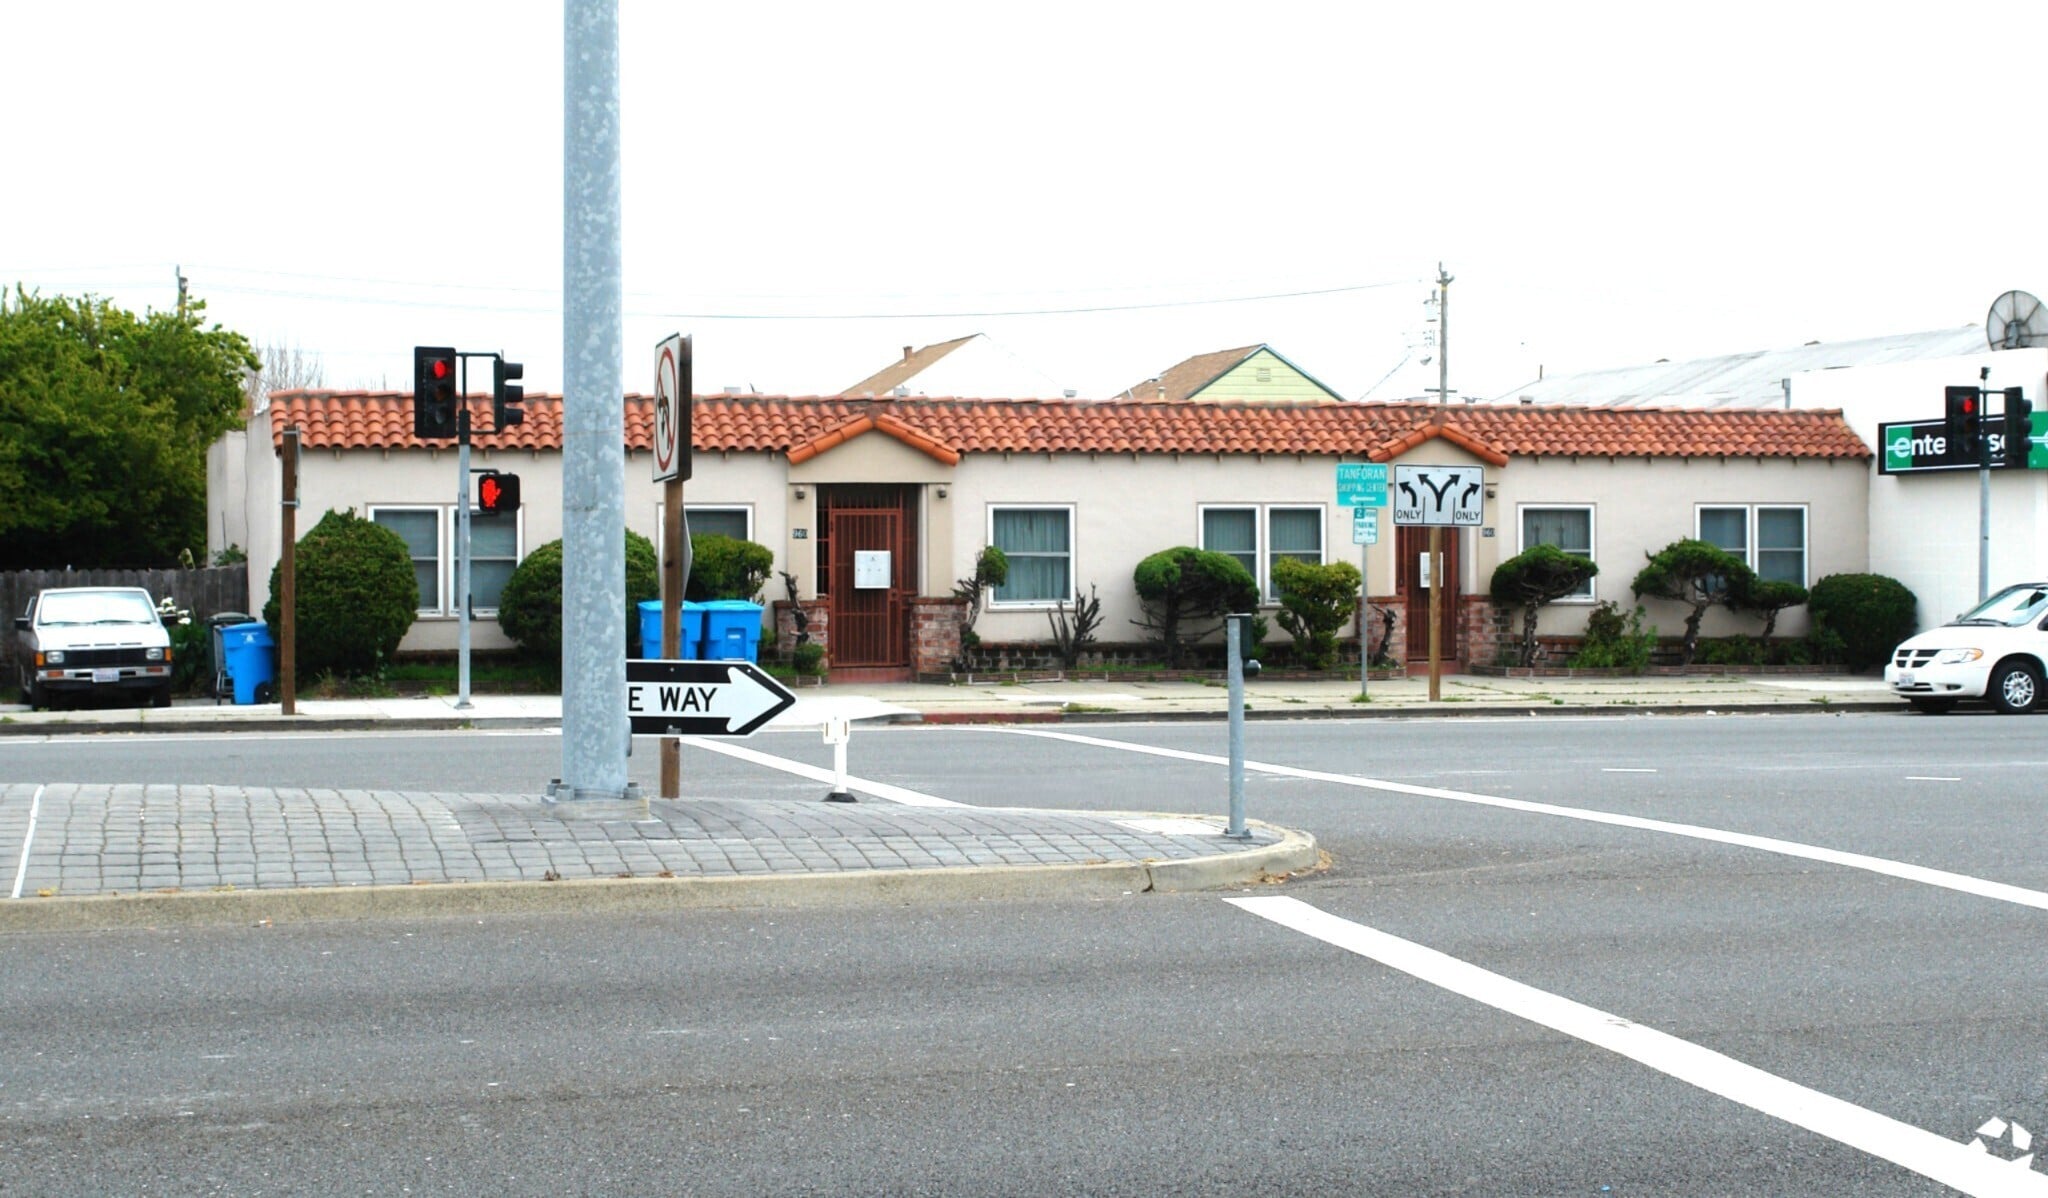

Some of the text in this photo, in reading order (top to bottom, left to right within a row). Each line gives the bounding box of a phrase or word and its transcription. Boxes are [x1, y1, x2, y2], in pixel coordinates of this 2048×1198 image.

[1339, 468, 1385, 480] TANFORAN
[1366, 482, 1385, 493] CENTER
[1396, 509, 1422, 520] ONLY
[1455, 510, 1481, 521] ONLY
[659, 686, 718, 712] WAY
